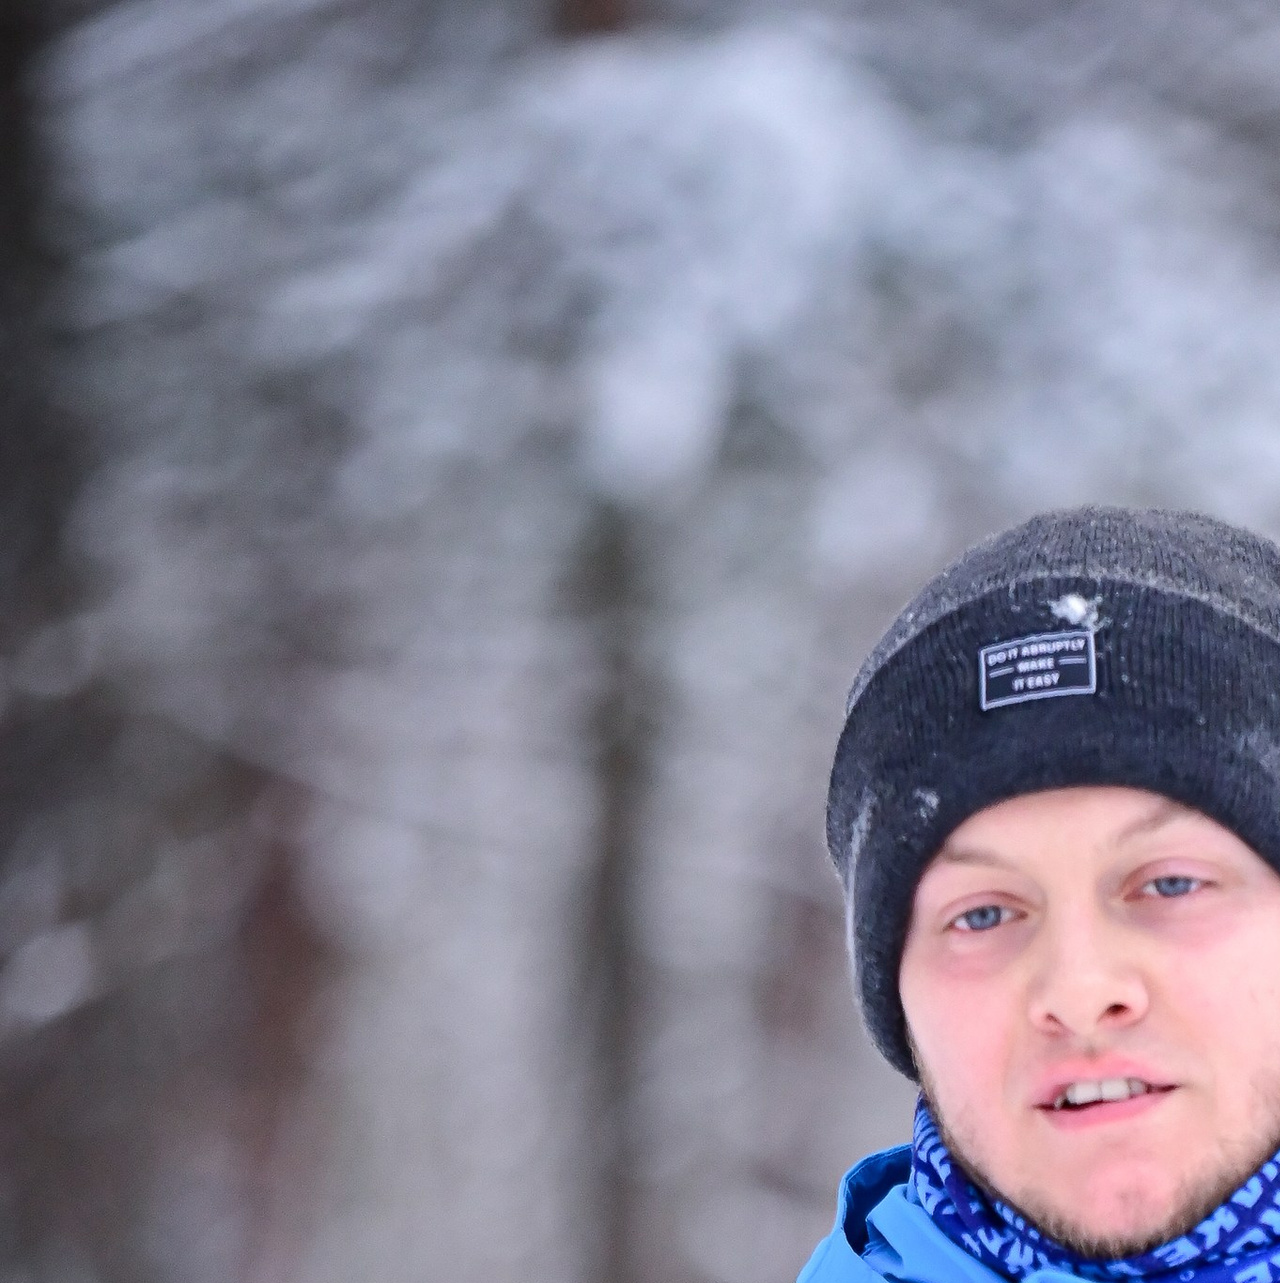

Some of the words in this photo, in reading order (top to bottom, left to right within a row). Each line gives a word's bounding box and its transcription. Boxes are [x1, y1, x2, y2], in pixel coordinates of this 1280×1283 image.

[989, 652, 1006, 666] DO
[1007, 647, 1019, 661] IT
[1021, 639, 1085, 656] ABRUPTLY
[1017, 657, 1055, 673] MAKE
[1013, 678, 1024, 691] IT
[1026, 671, 1060, 690] EASY
